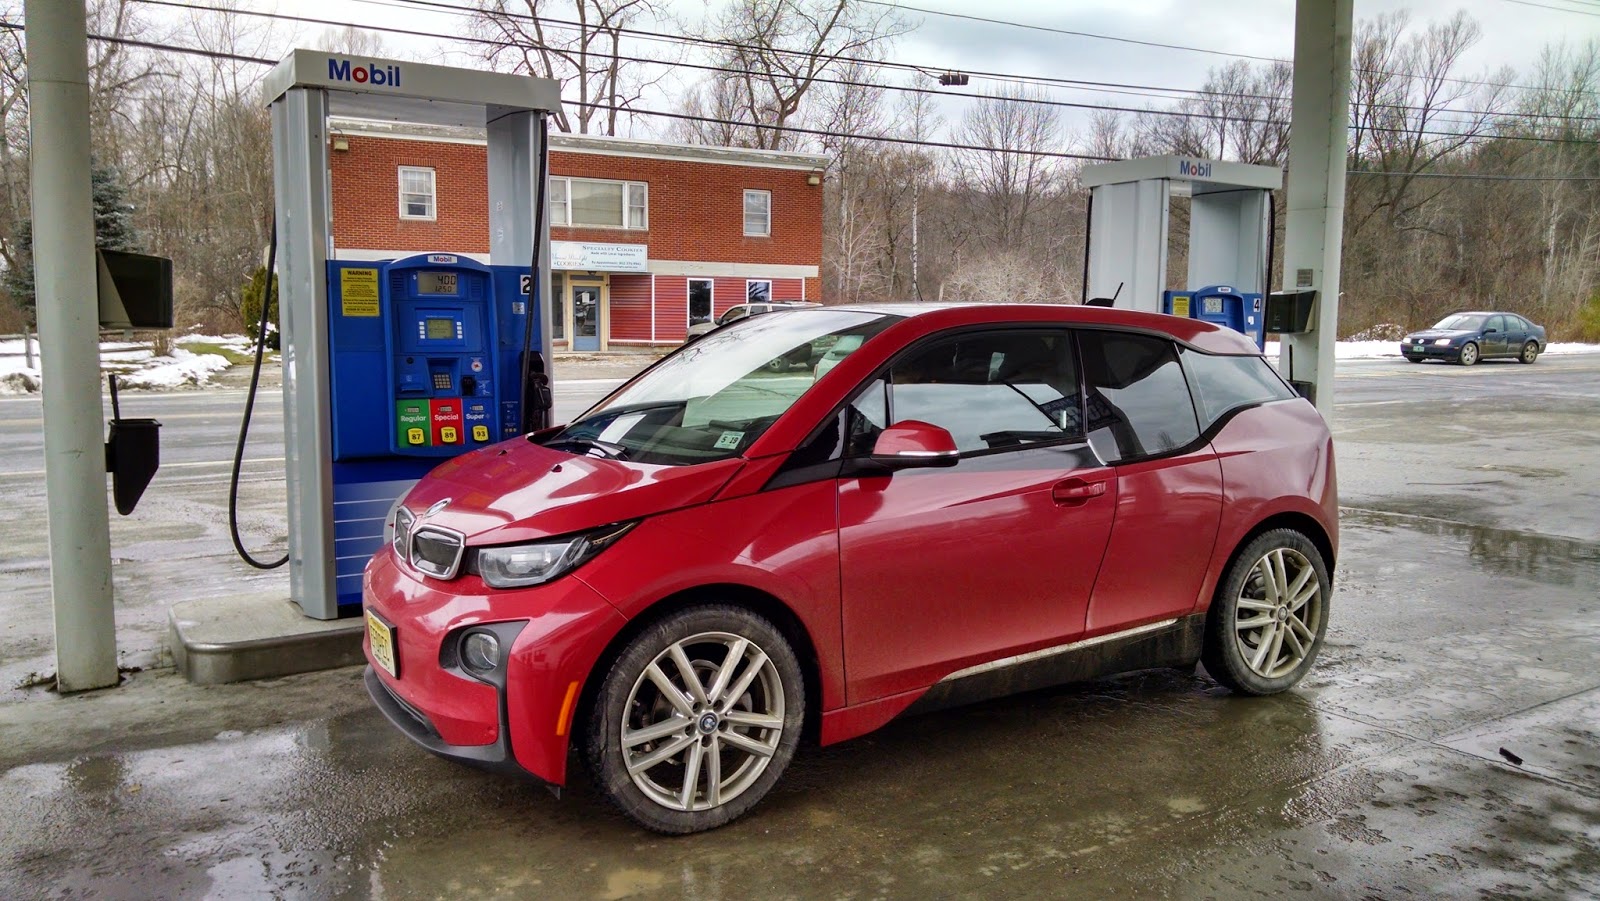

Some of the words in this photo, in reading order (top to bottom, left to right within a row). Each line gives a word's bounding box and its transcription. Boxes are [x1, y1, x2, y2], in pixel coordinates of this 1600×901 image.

[329, 59, 400, 86] Mobil
[1180, 160, 1212, 177] Mobil
[522, 276, 531, 294] 2
[1254, 299, 1260, 311] 4
[400, 415, 427, 423] Regular
[434, 414, 459, 422] Special
